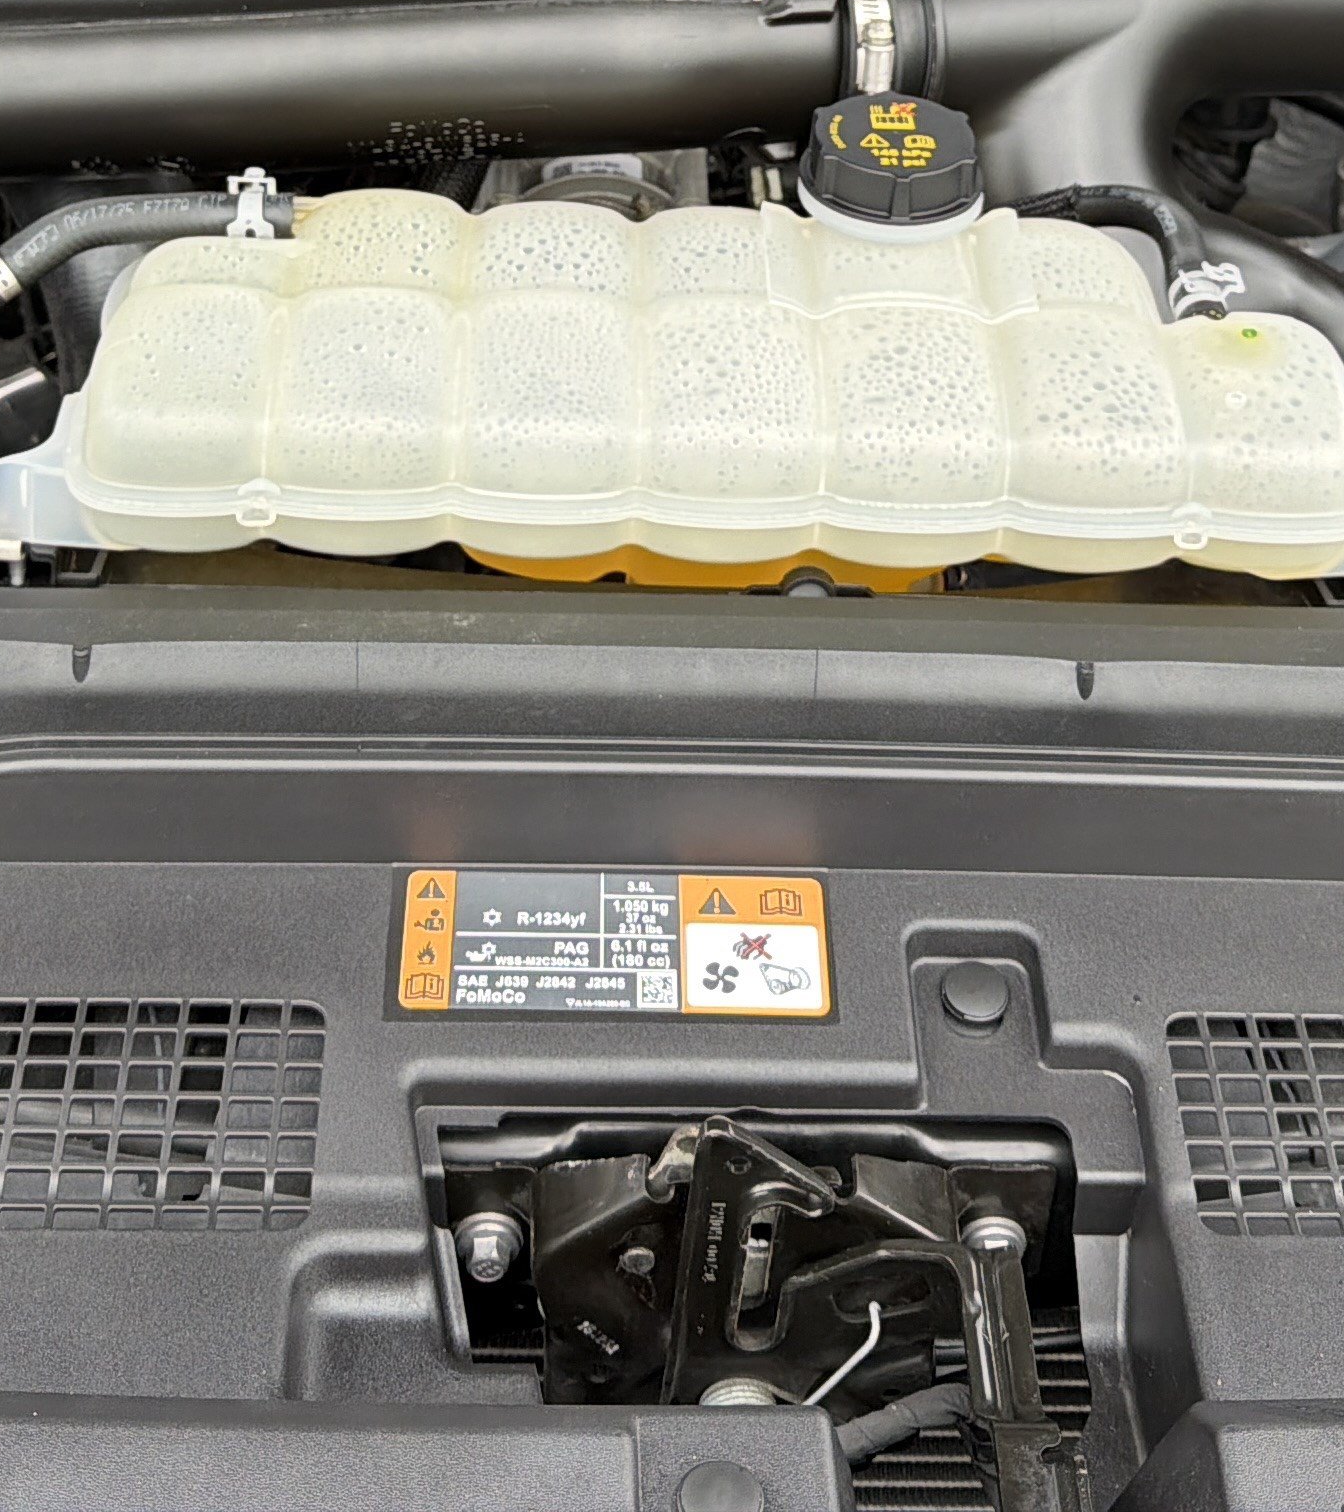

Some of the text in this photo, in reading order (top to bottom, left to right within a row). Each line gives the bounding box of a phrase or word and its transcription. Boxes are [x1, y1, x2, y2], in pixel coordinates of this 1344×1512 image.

[613, 899, 669, 917] 1.050 kg
[517, 910, 587, 929] R-1234yf
[626, 912, 656, 925] 37 oz
[619, 922, 663, 935] 2.31 lbs
[554, 941, 589, 956] PAG
[610, 939, 669, 954] 6.1 fl oz
[647, 955, 671, 970] cc)
[457, 974, 488, 988] SAE
[455, 989, 526, 1004] FoMoCo
